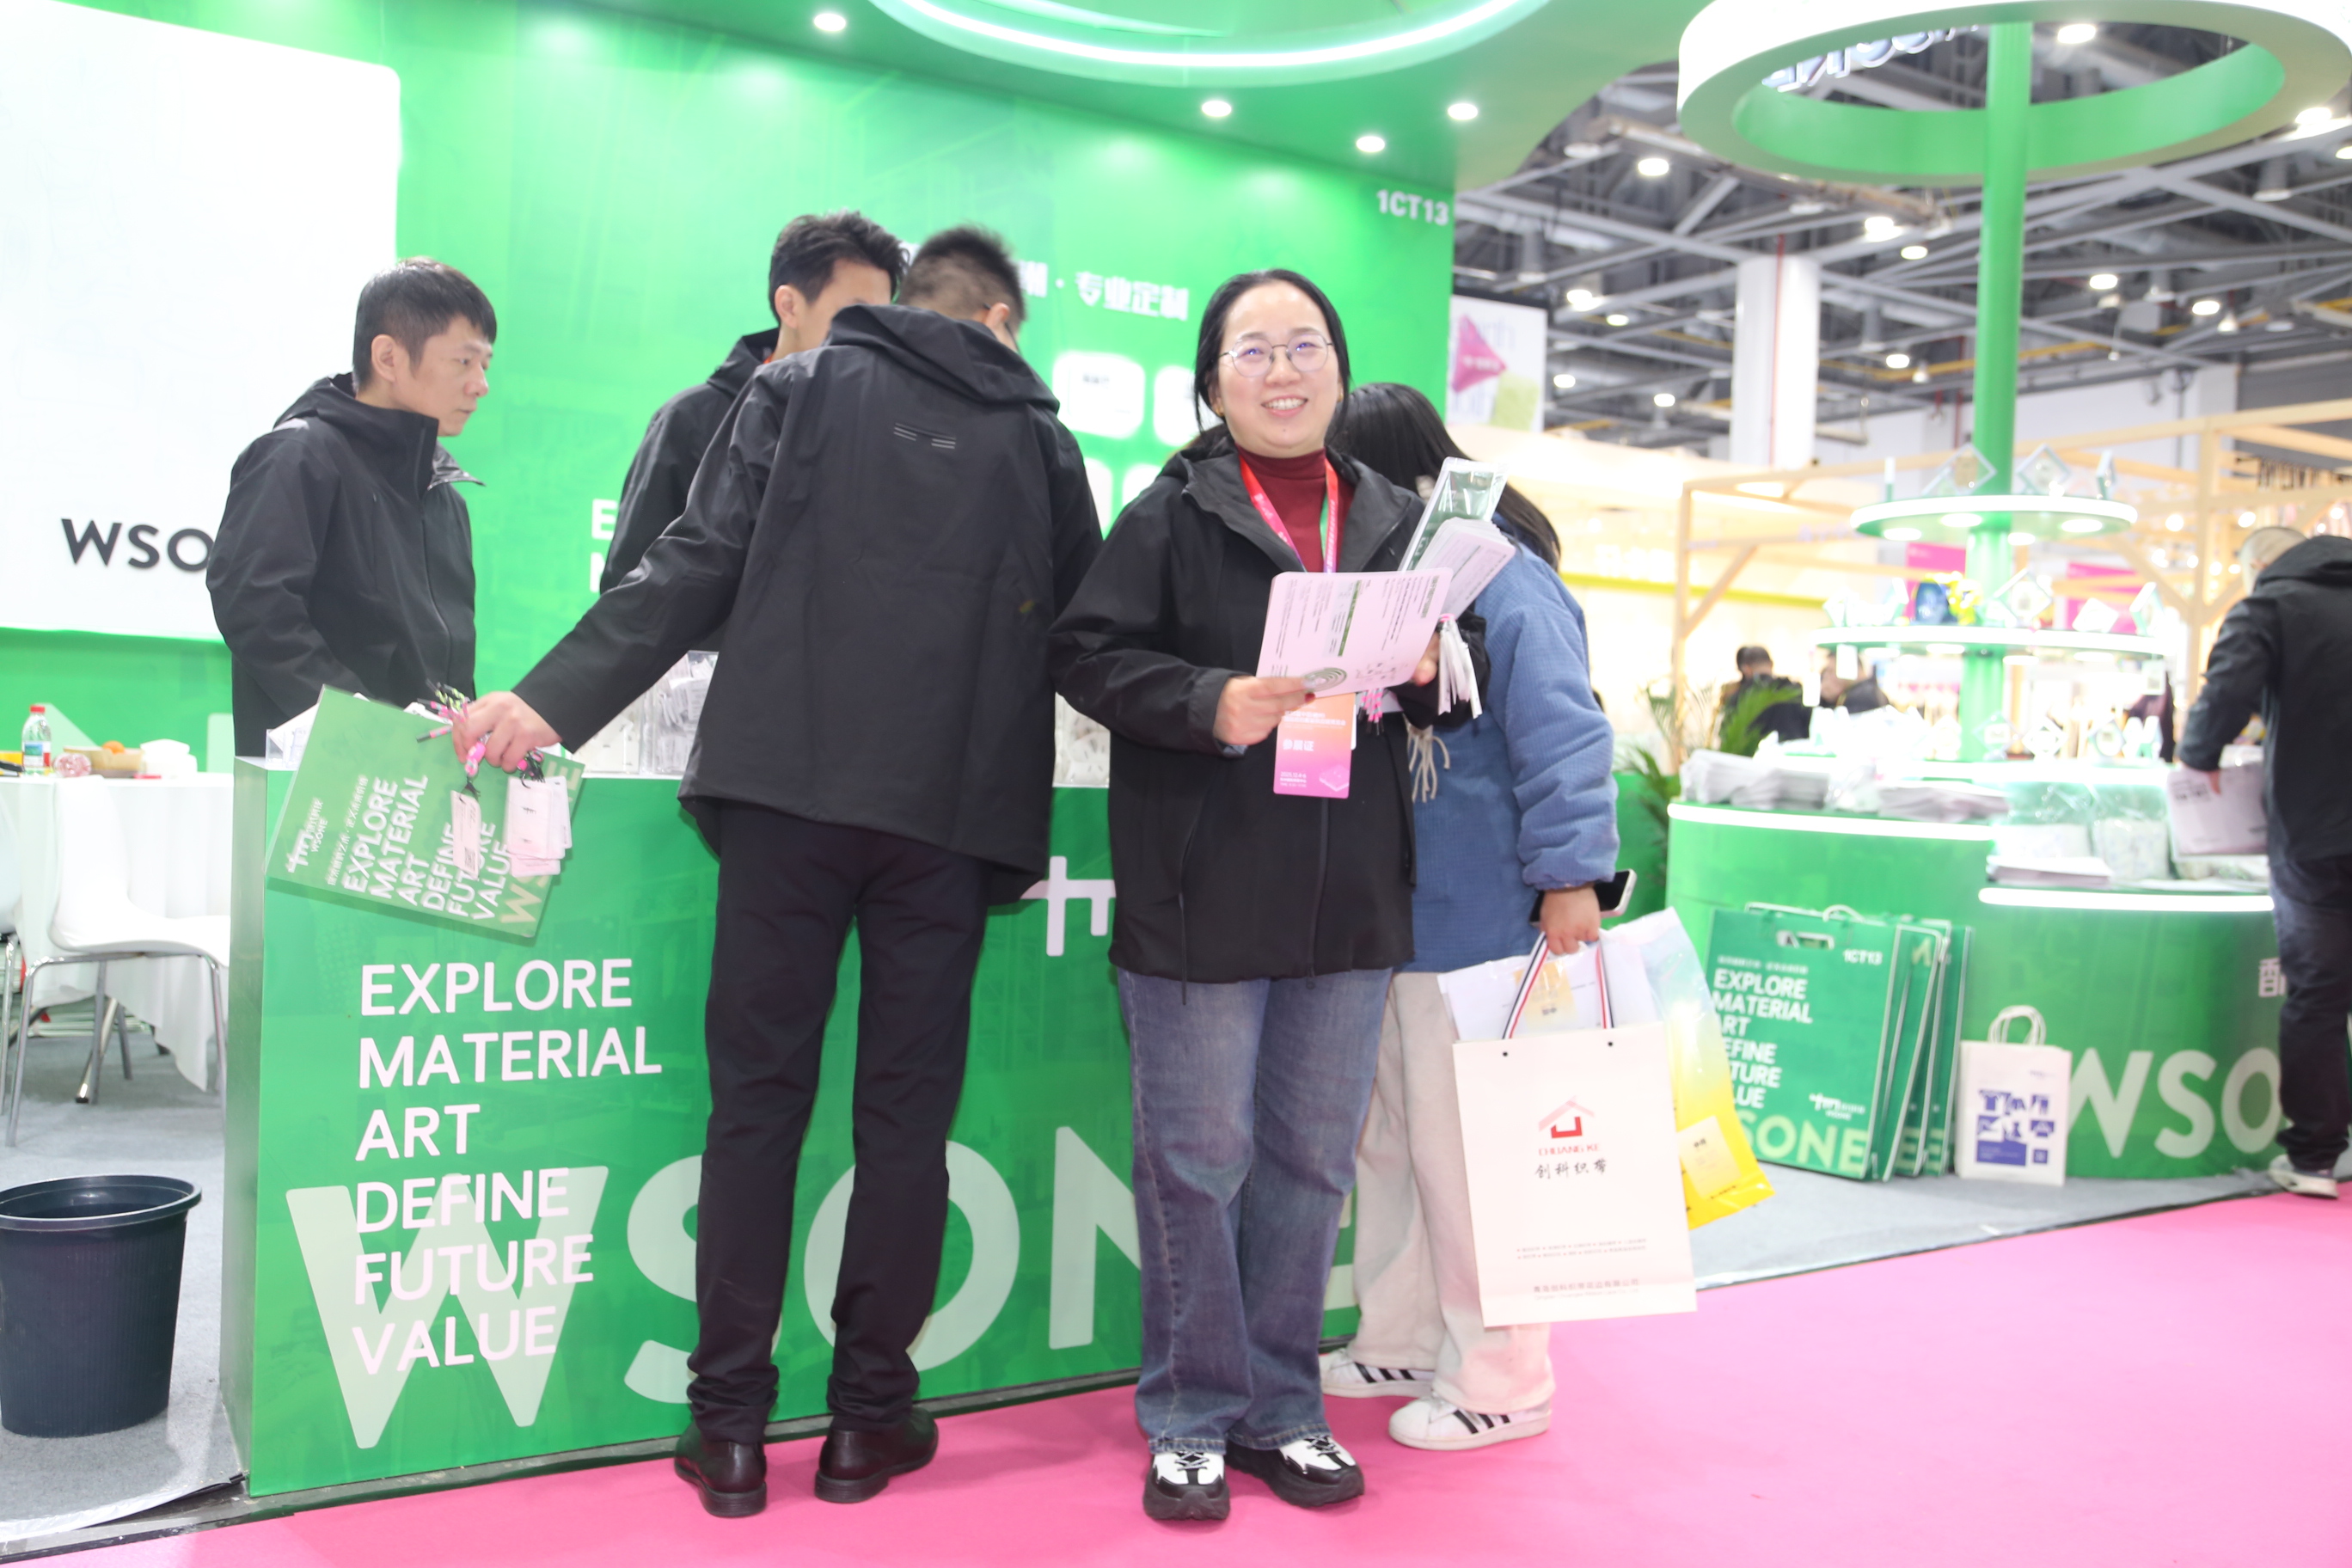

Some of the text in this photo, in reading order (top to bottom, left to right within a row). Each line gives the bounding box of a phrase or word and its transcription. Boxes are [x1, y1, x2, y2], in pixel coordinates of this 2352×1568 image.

[1376, 189, 1449, 226] 1CT13
[341, 776, 398, 892] EXPLORE
[368, 775, 428, 899] MATERIAL
[395, 852, 430, 906] ART
[1713, 967, 1808, 1001] EXPLORE
[1843, 948, 1883, 966] 1CT13
[360, 958, 632, 1016] EXPLORE
[1712, 989, 1813, 1024] MATERIAL
[1721, 1014, 1751, 1037] RT
[1724, 1038, 1778, 1064] EFINE
[359, 1026, 662, 1089] MATERIAL
[1729, 1060, 1782, 1088] TURE
[1732, 1083, 1767, 1108] LUE
[355, 1103, 481, 1161] ART
[1736, 1109, 1867, 1175] SONE
[355, 1167, 569, 1234] DEFINE
[354, 1234, 594, 1304] FUTURE
[352, 1306, 556, 1375] VALUE
